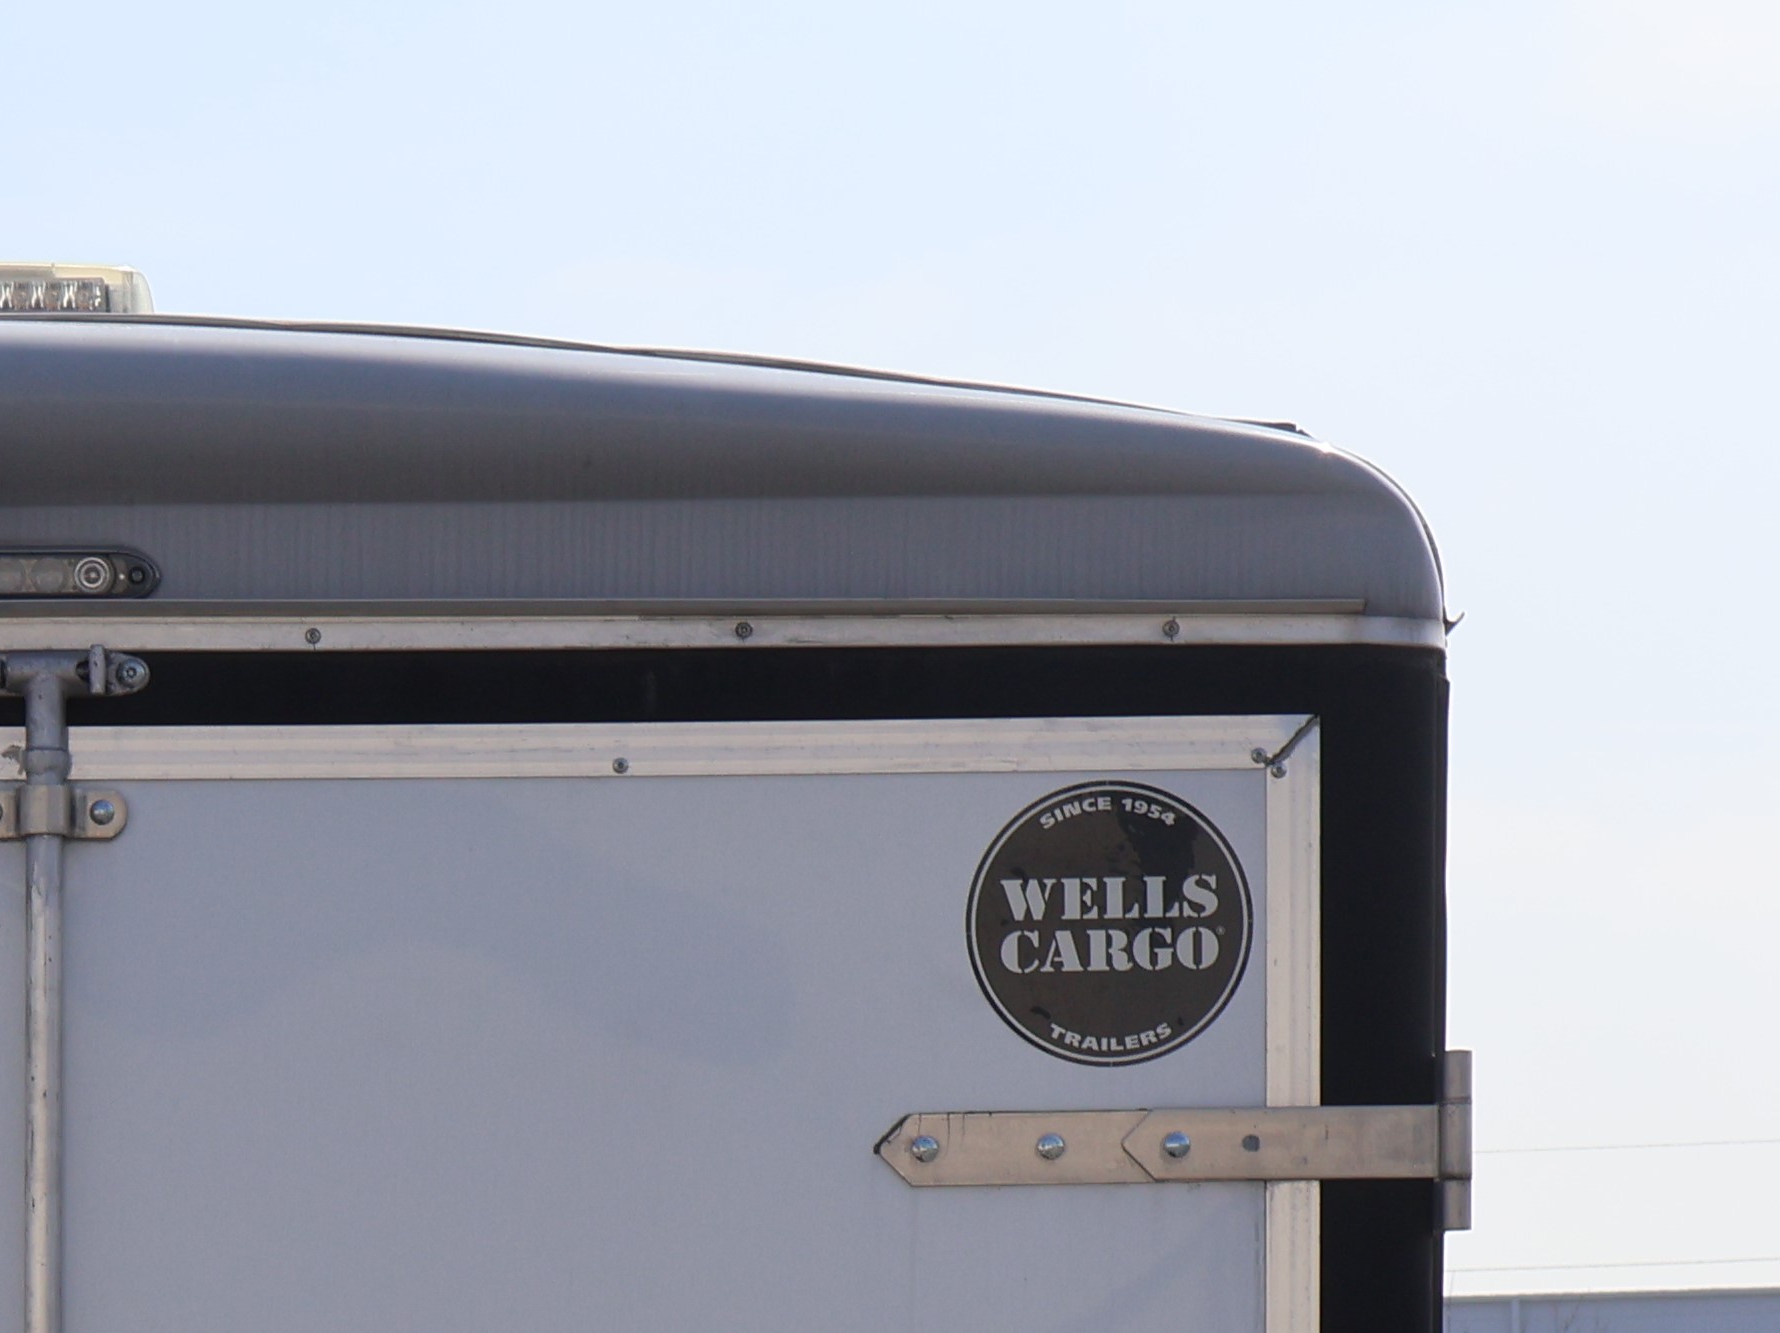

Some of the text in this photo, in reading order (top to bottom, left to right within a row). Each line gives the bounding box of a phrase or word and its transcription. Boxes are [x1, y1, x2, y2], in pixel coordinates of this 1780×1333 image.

[1039, 796, 1177, 829] SINCE 1954
[999, 873, 1219, 922] WELLS
[999, 926, 1220, 974] CARGO
[1049, 1022, 1173, 1052] TRAILERS
